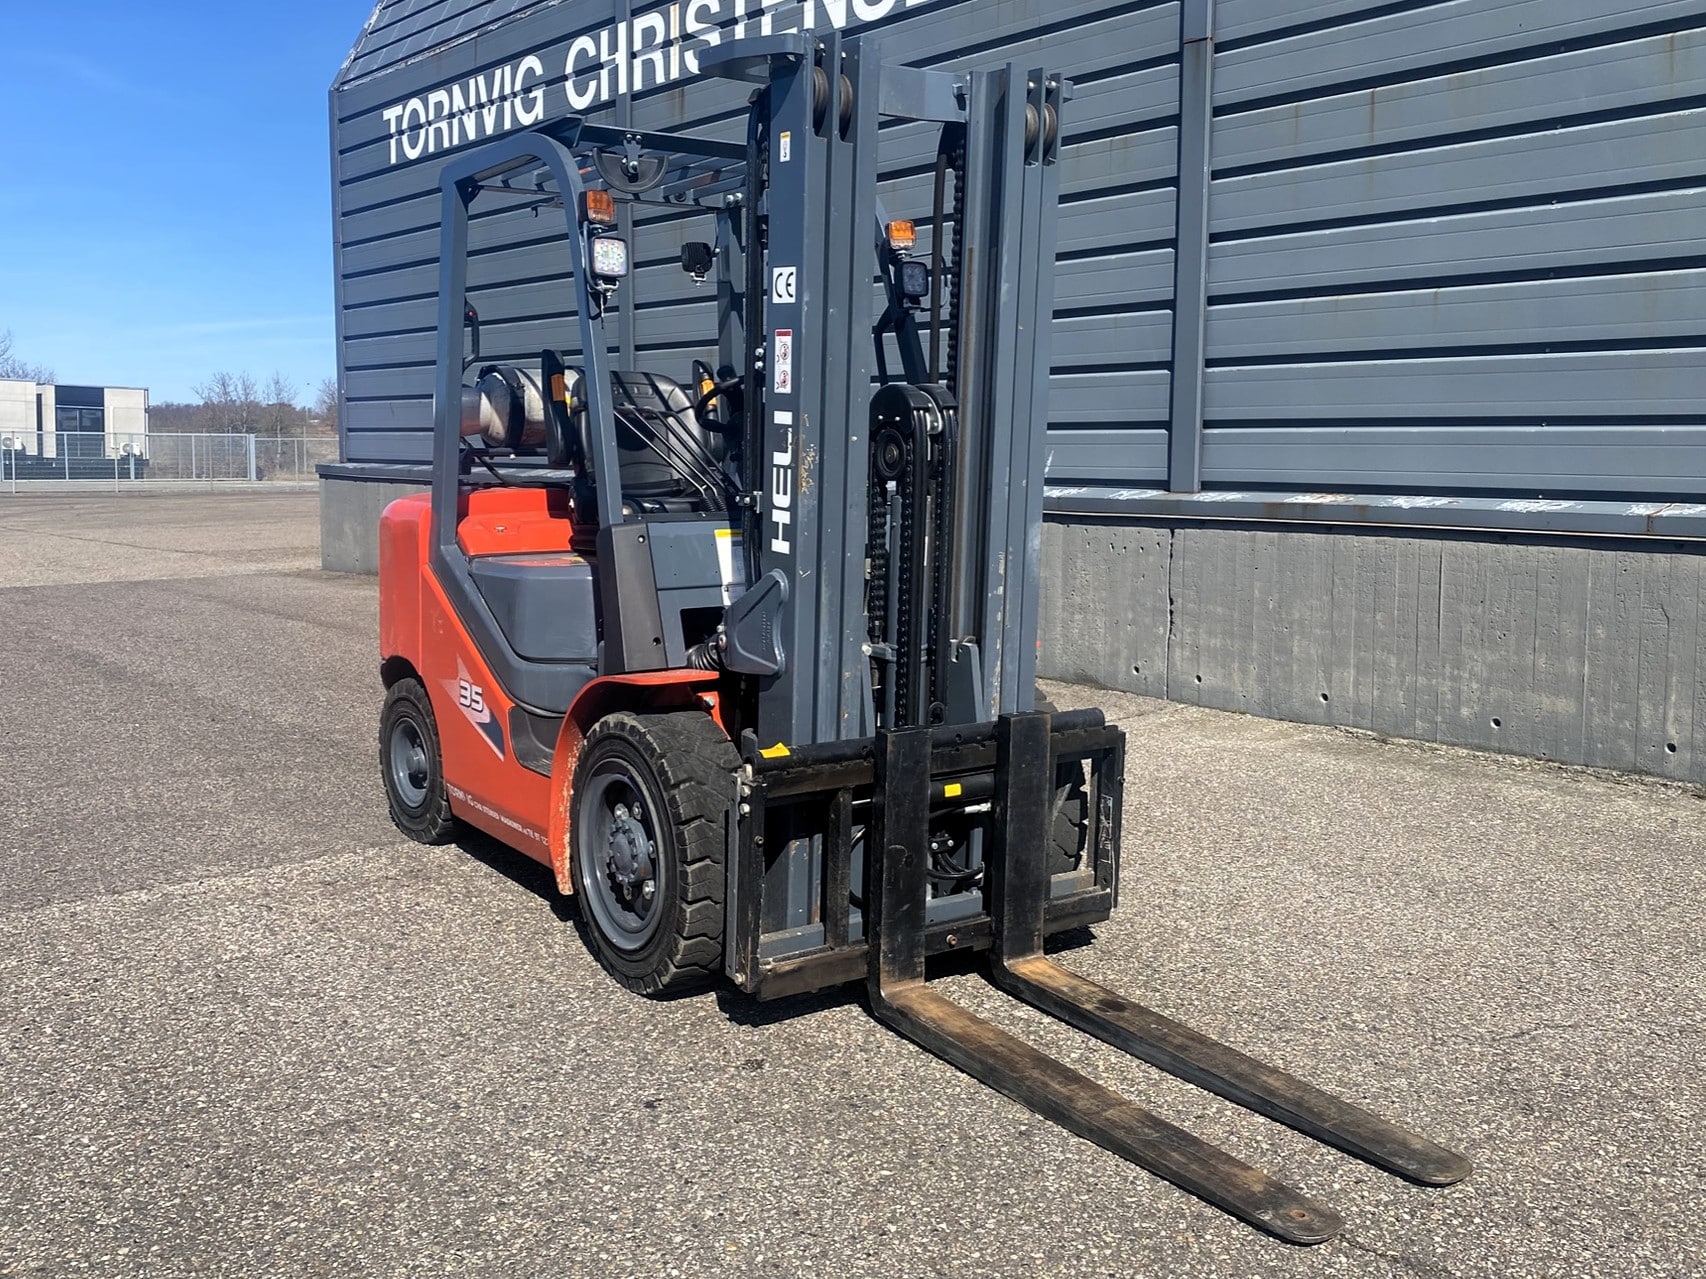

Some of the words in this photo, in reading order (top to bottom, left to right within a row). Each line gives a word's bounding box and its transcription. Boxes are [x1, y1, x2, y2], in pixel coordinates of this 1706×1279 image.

[383, 55, 546, 164] TORNVIG
[774, 271, 794, 298] CE
[771, 410, 793, 555] HELI
[459, 679, 484, 712] 35
